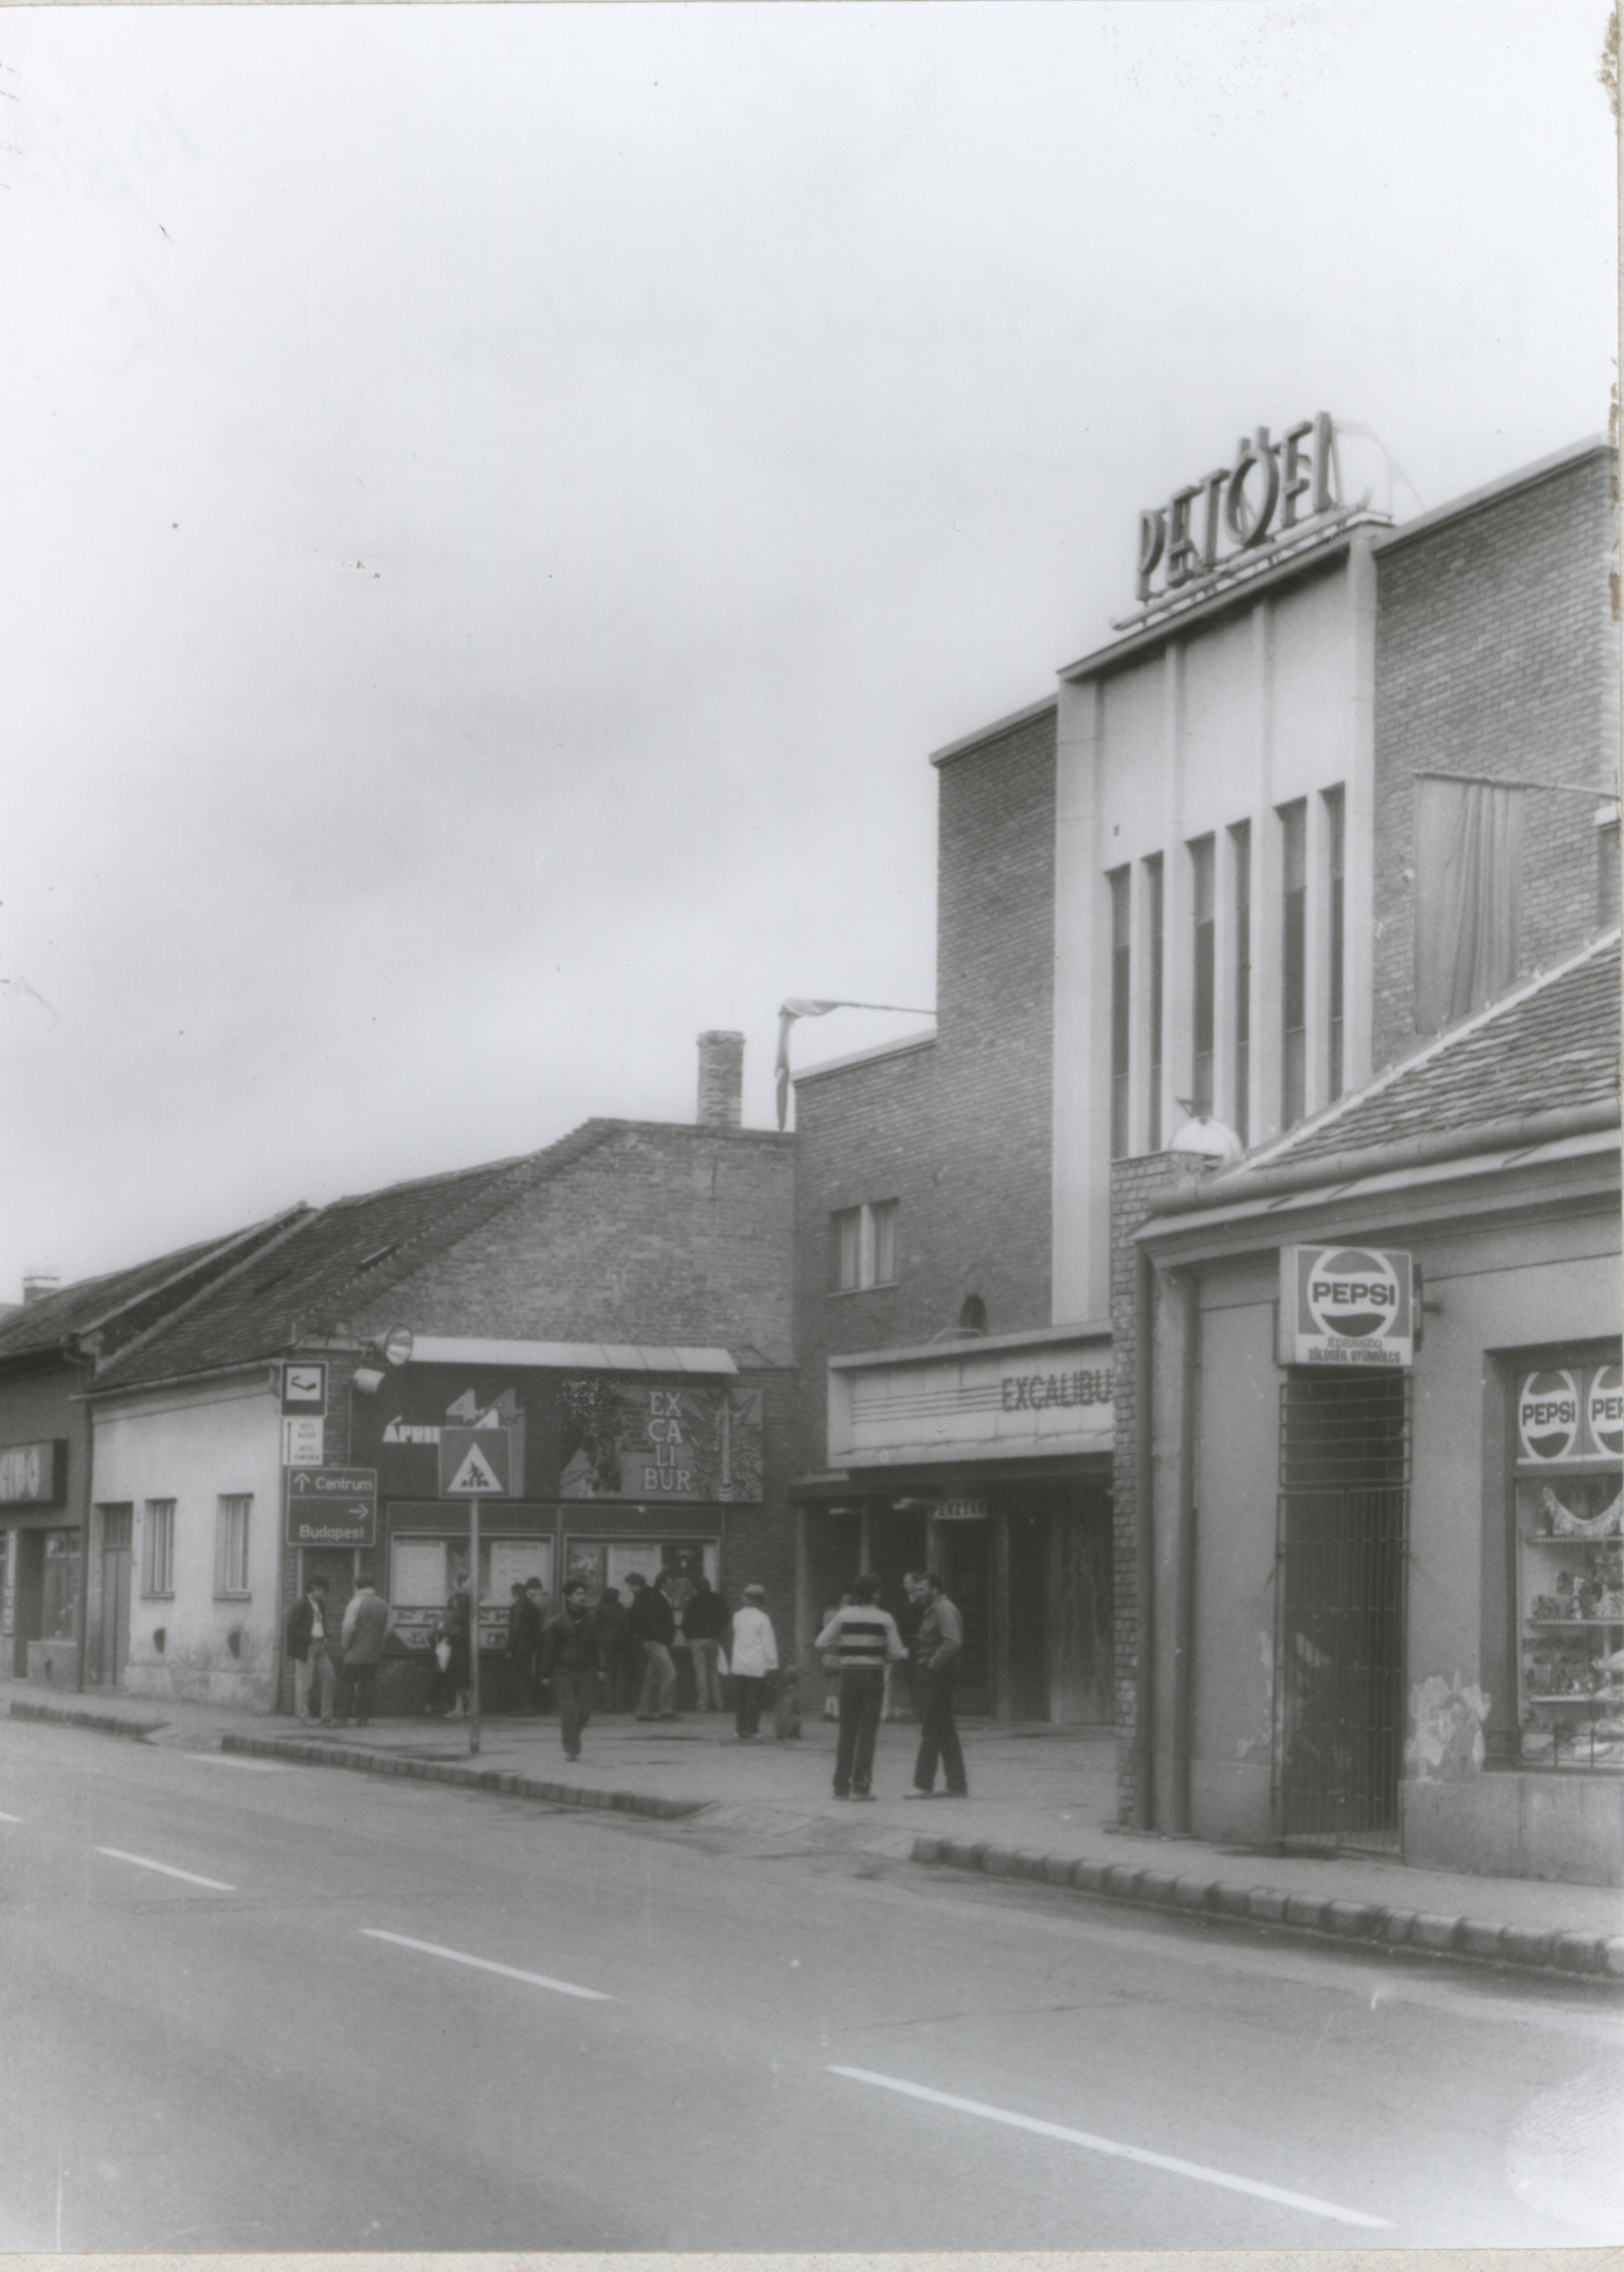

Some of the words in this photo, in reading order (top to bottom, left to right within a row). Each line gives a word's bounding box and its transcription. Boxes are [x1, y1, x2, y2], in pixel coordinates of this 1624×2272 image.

[1137, 411, 1332, 601] PETŐFI
[1313, 1282, 1395, 1306] PEPSI
[649, 1391, 682, 1417] EX
[1522, 1400, 1576, 1426] PEPSI
[648, 1418, 683, 1444] CA
[655, 1444, 676, 1466] LI
[316, 1476, 373, 1491] Centrum
[643, 1468, 692, 1491] BUR
[300, 1524, 365, 1542] Budapest
